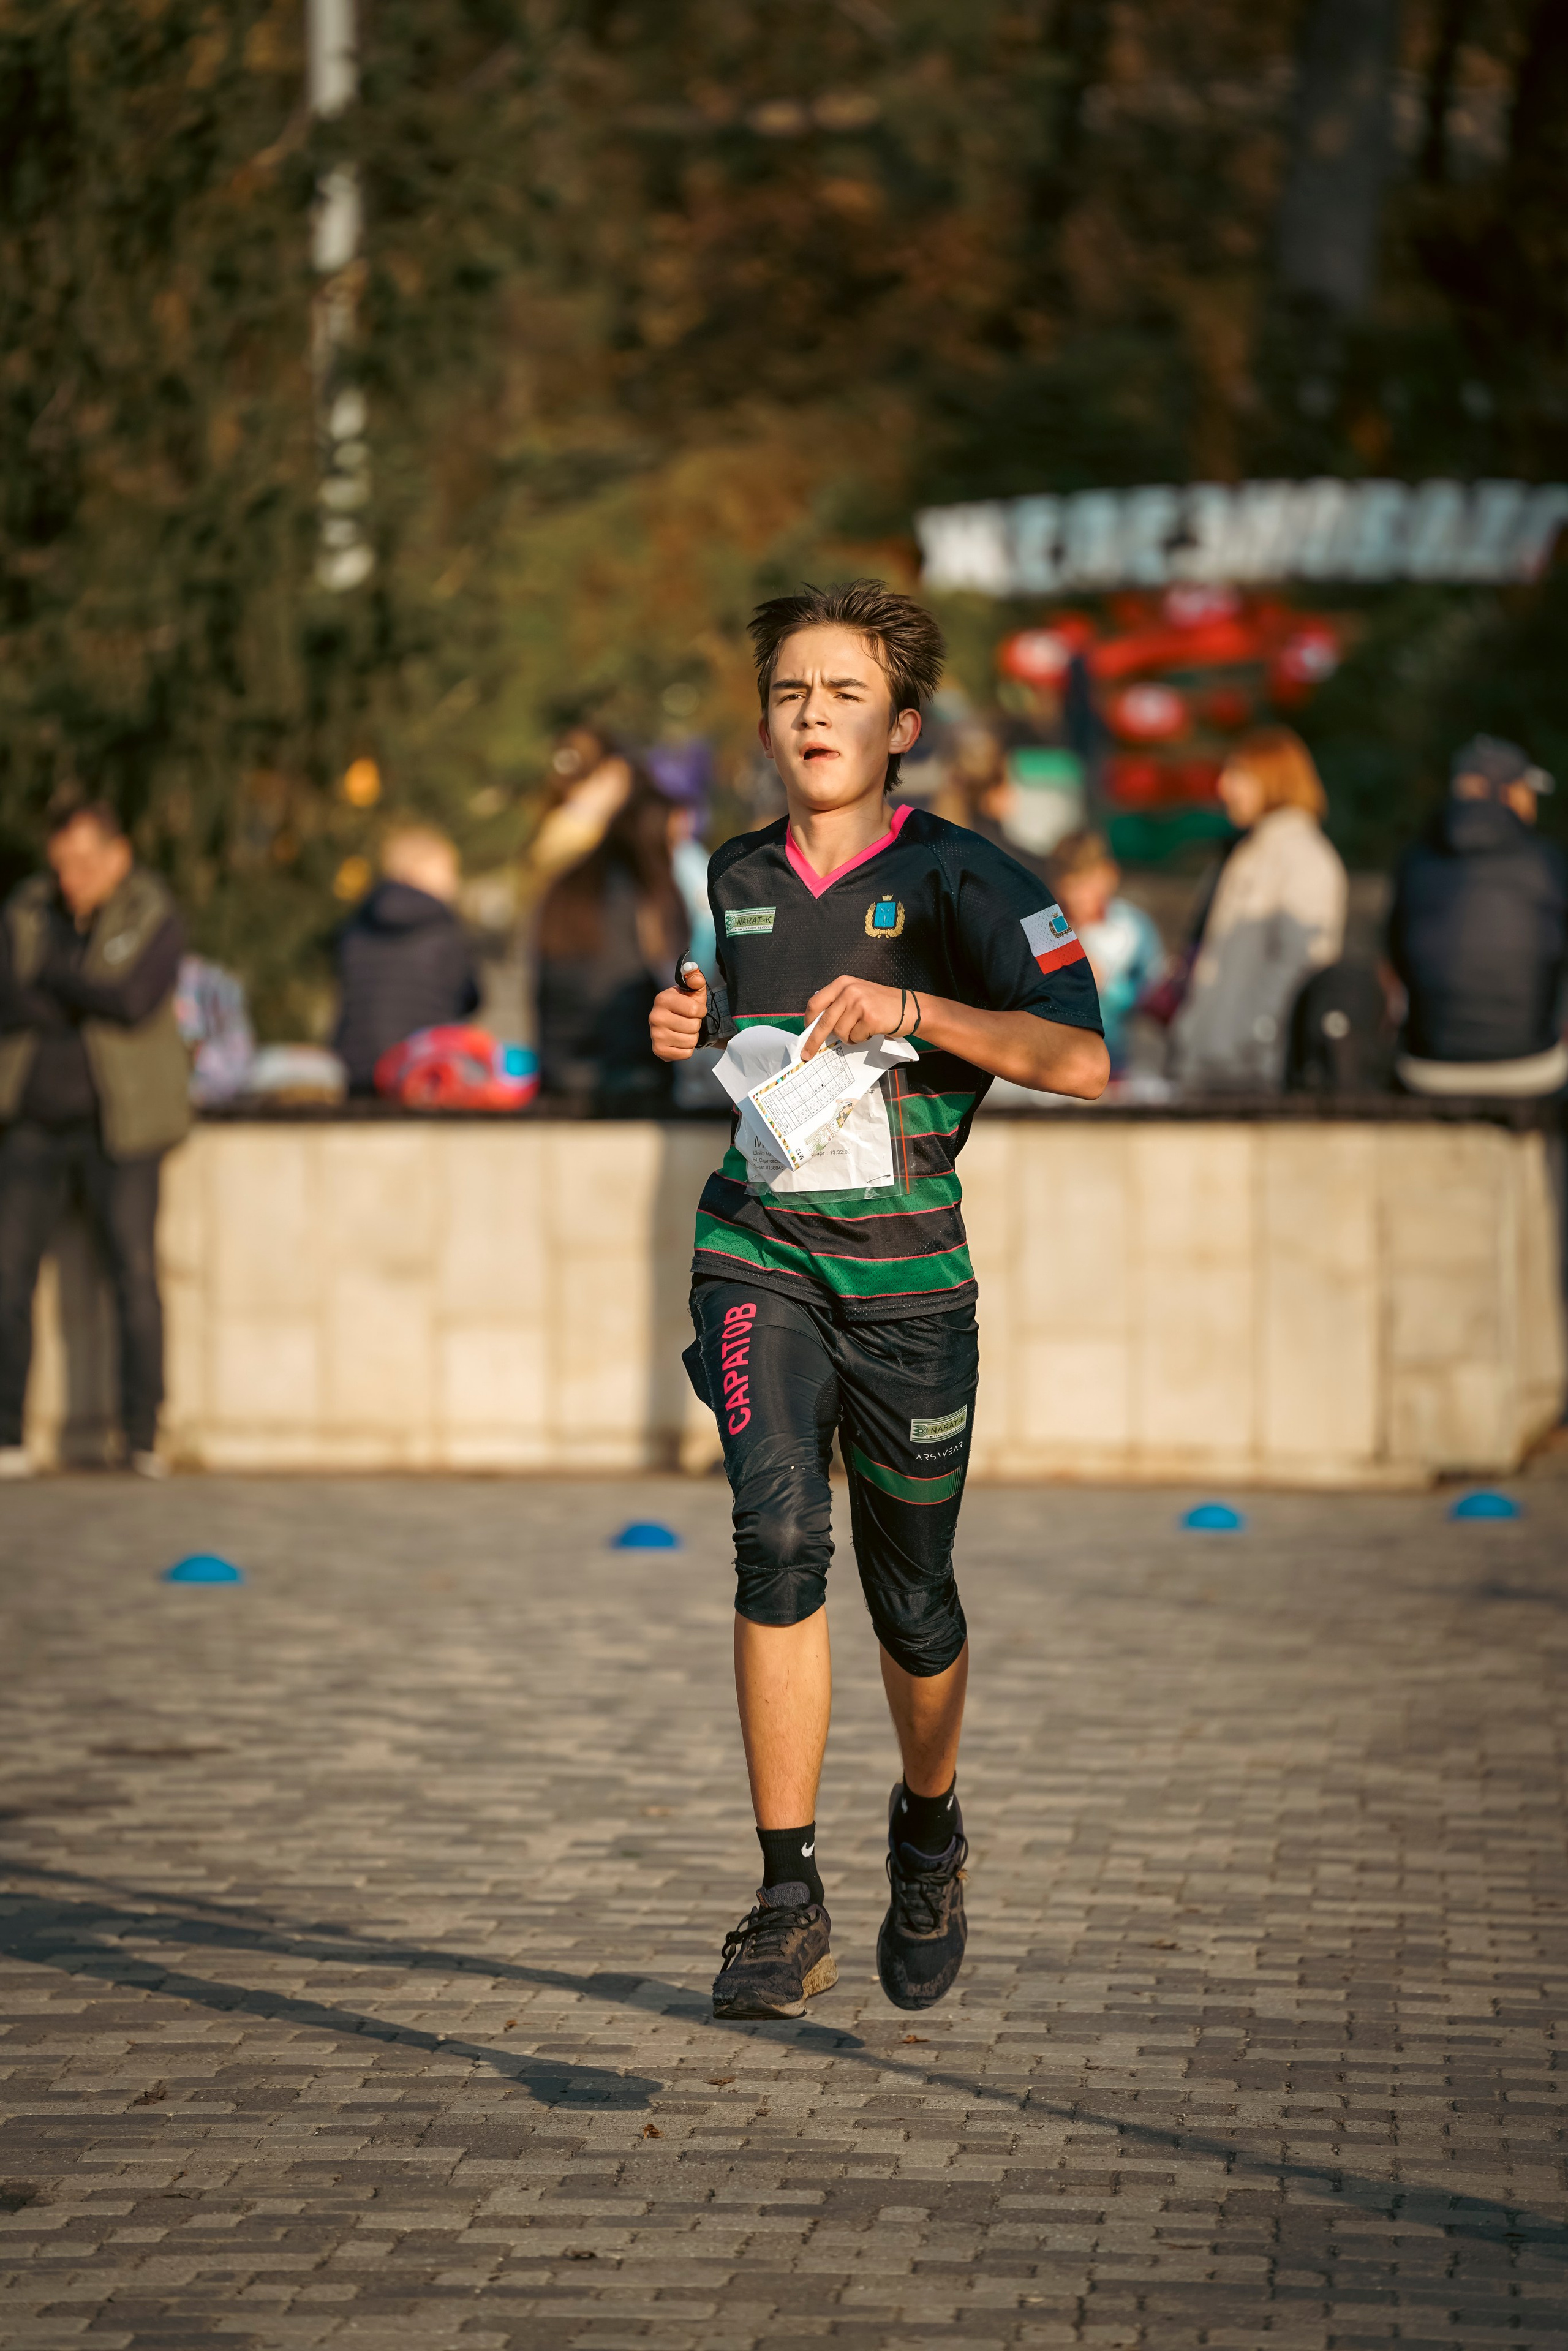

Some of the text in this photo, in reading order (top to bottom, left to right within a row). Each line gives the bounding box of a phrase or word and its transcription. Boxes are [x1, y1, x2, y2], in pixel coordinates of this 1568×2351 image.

[736, 916, 772, 926] NARAT-K
[722, 1303, 757, 1435] САРАТОВ
[931, 1415, 965, 1433] NARAT-K
